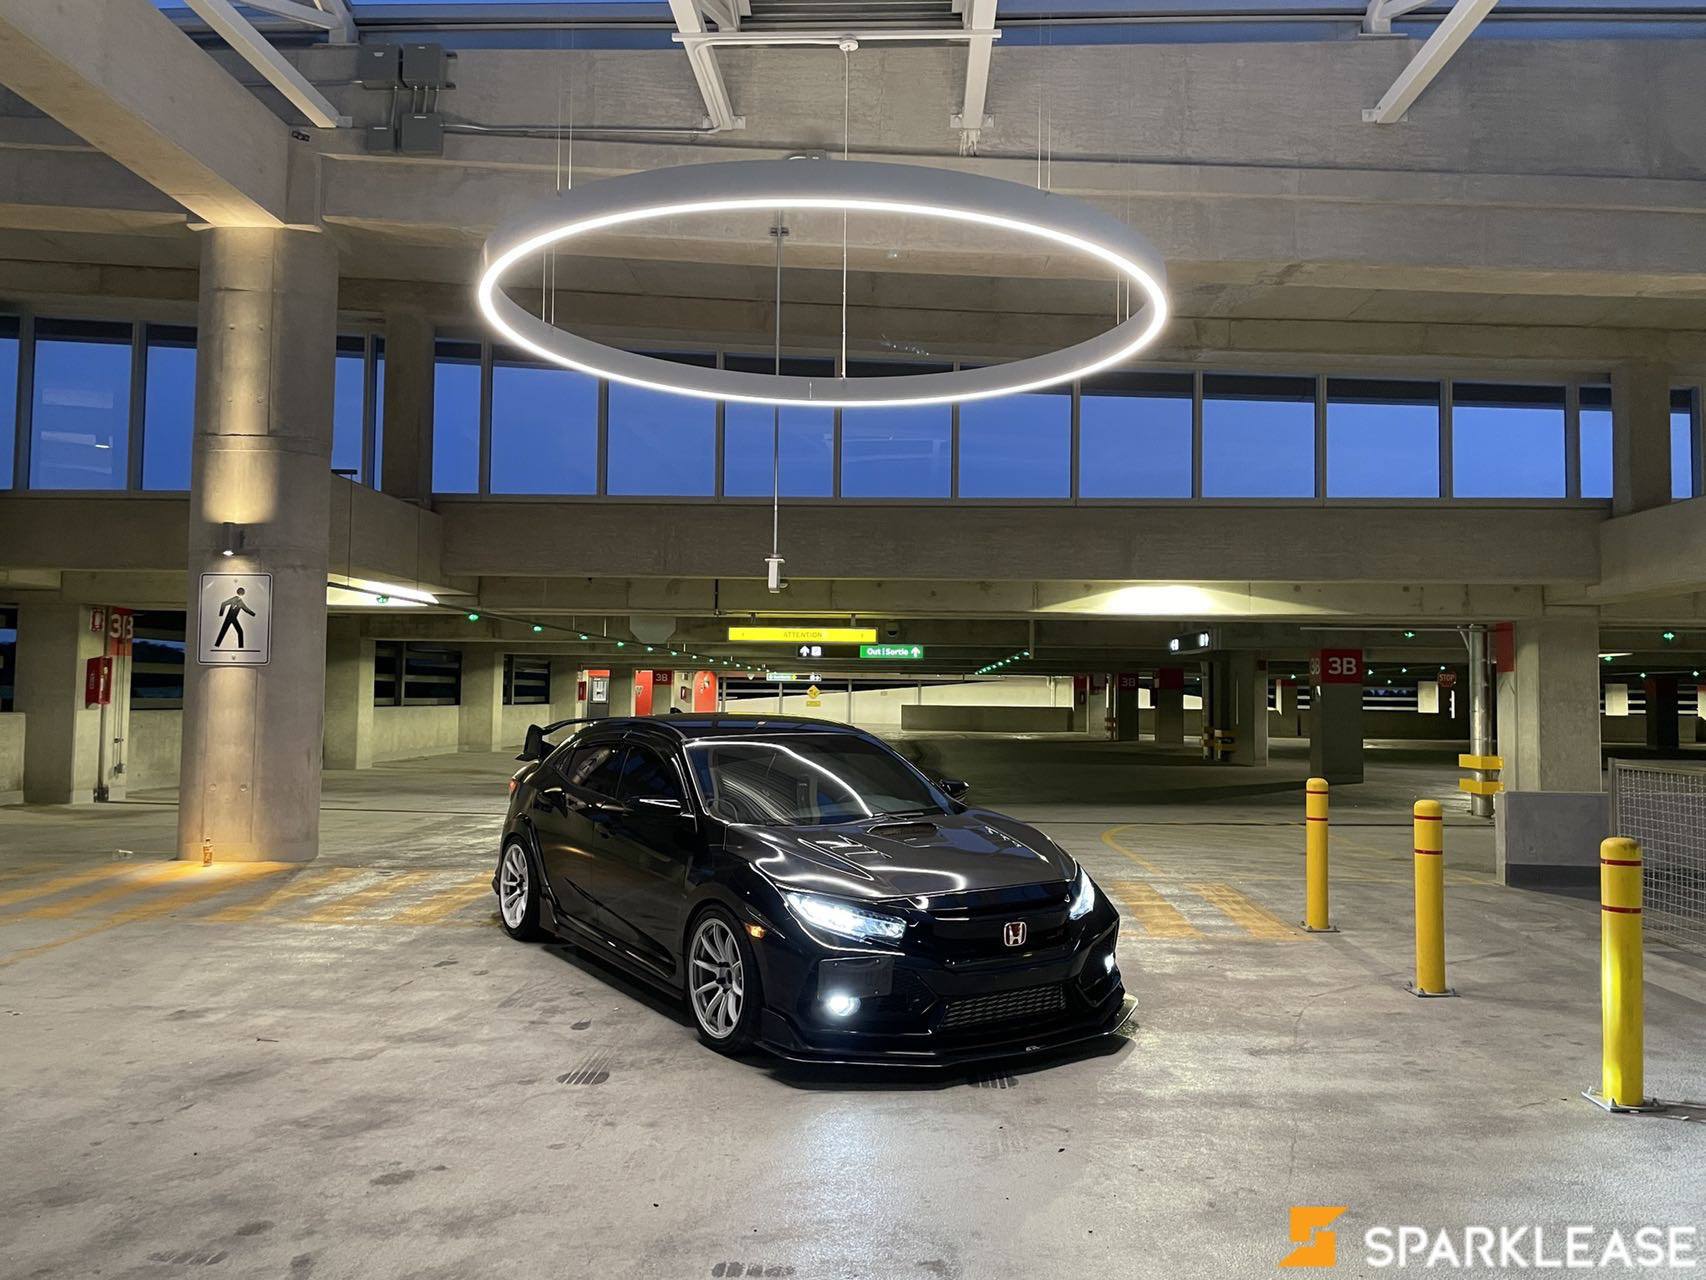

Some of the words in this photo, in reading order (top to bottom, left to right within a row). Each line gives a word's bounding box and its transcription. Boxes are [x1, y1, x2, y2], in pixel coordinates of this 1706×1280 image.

[783, 630, 823, 638] ATTENTION
[867, 647, 881, 656] Out
[1328, 656, 1357, 675] 3B
[655, 673, 668, 682] 3B
[1439, 673, 1455, 682] STOP
[1121, 678, 1136, 687] 3B
